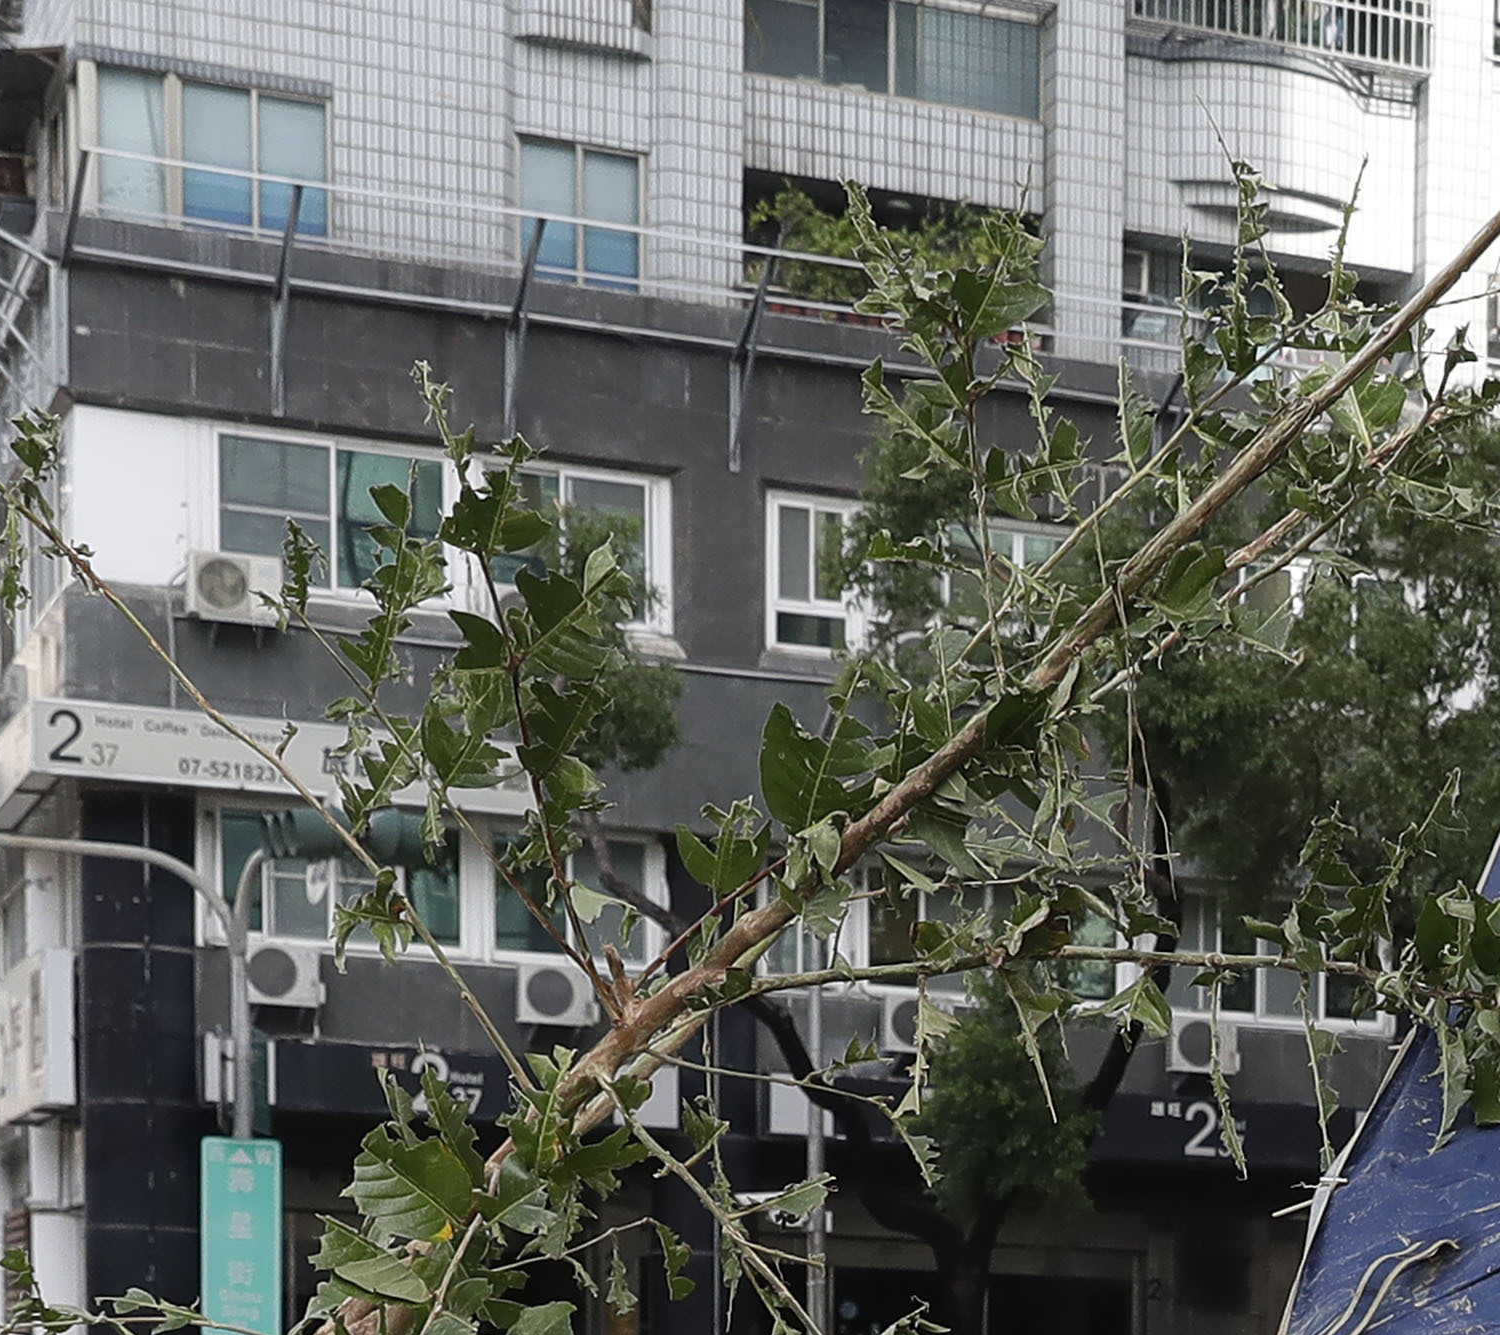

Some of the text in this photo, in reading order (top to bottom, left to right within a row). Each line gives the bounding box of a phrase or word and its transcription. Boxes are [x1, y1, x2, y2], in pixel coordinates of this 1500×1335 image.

[49, 709, 120, 768] 2 37
[94, 714, 134, 730] Hotel
[143, 720, 189, 737] Coffee
[1184, 1101, 1217, 1157] 2
